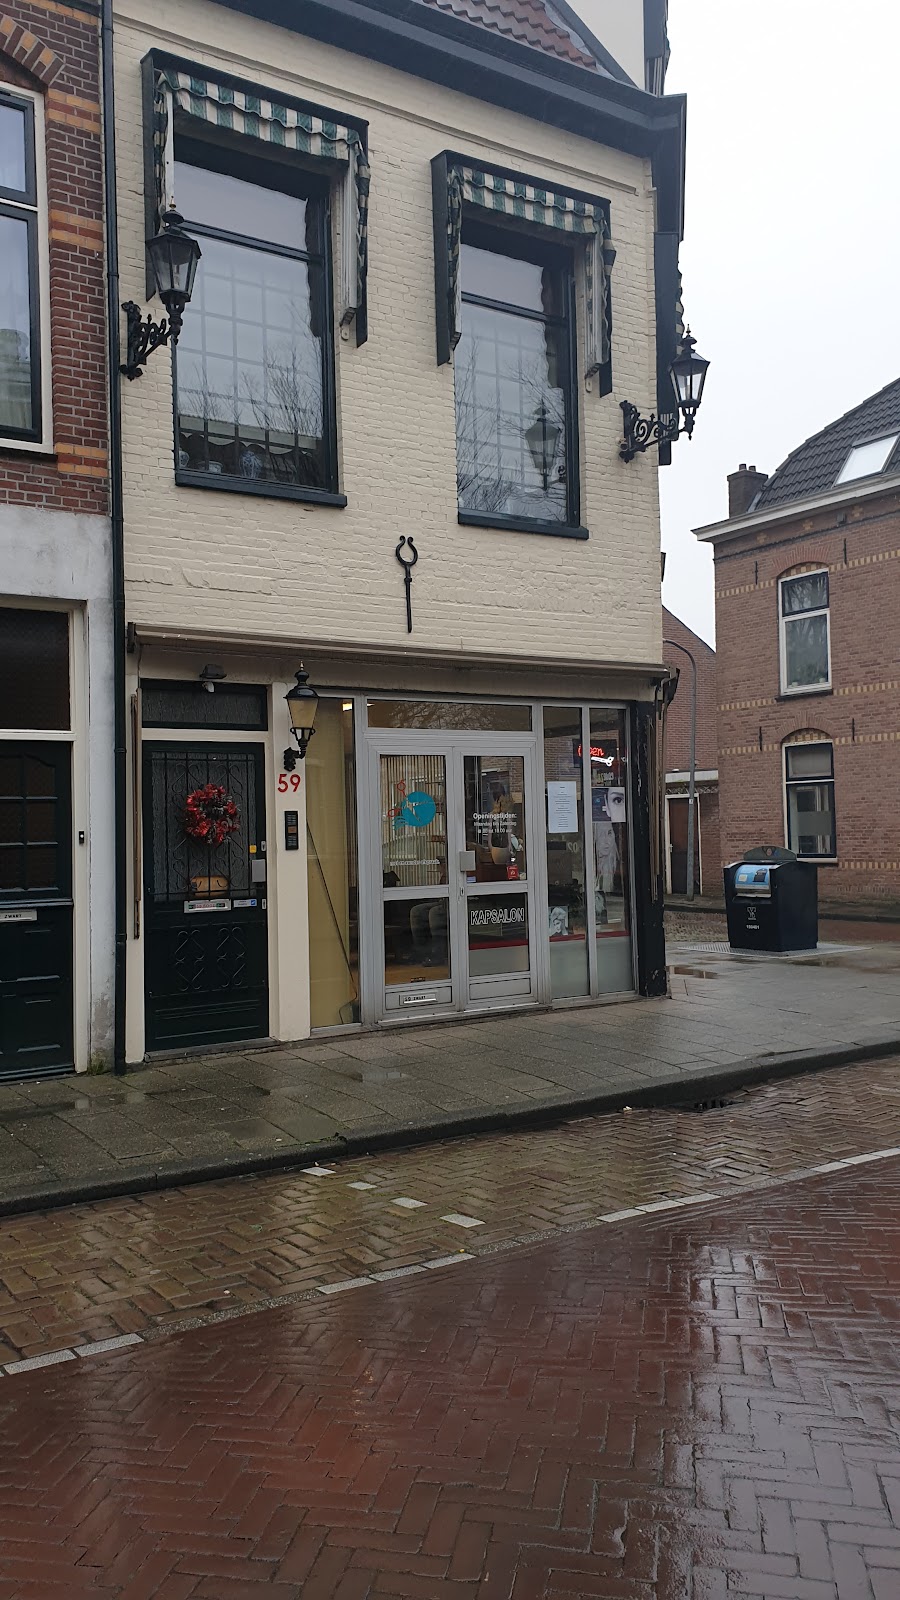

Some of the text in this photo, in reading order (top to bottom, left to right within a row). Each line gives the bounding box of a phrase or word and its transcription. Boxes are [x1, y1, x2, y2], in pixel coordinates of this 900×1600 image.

[577, 744, 605, 757] Oen
[277, 773, 301, 793] 59
[473, 812, 517, 821] Openingstijden:
[470, 907, 525, 926] KAPSALON
